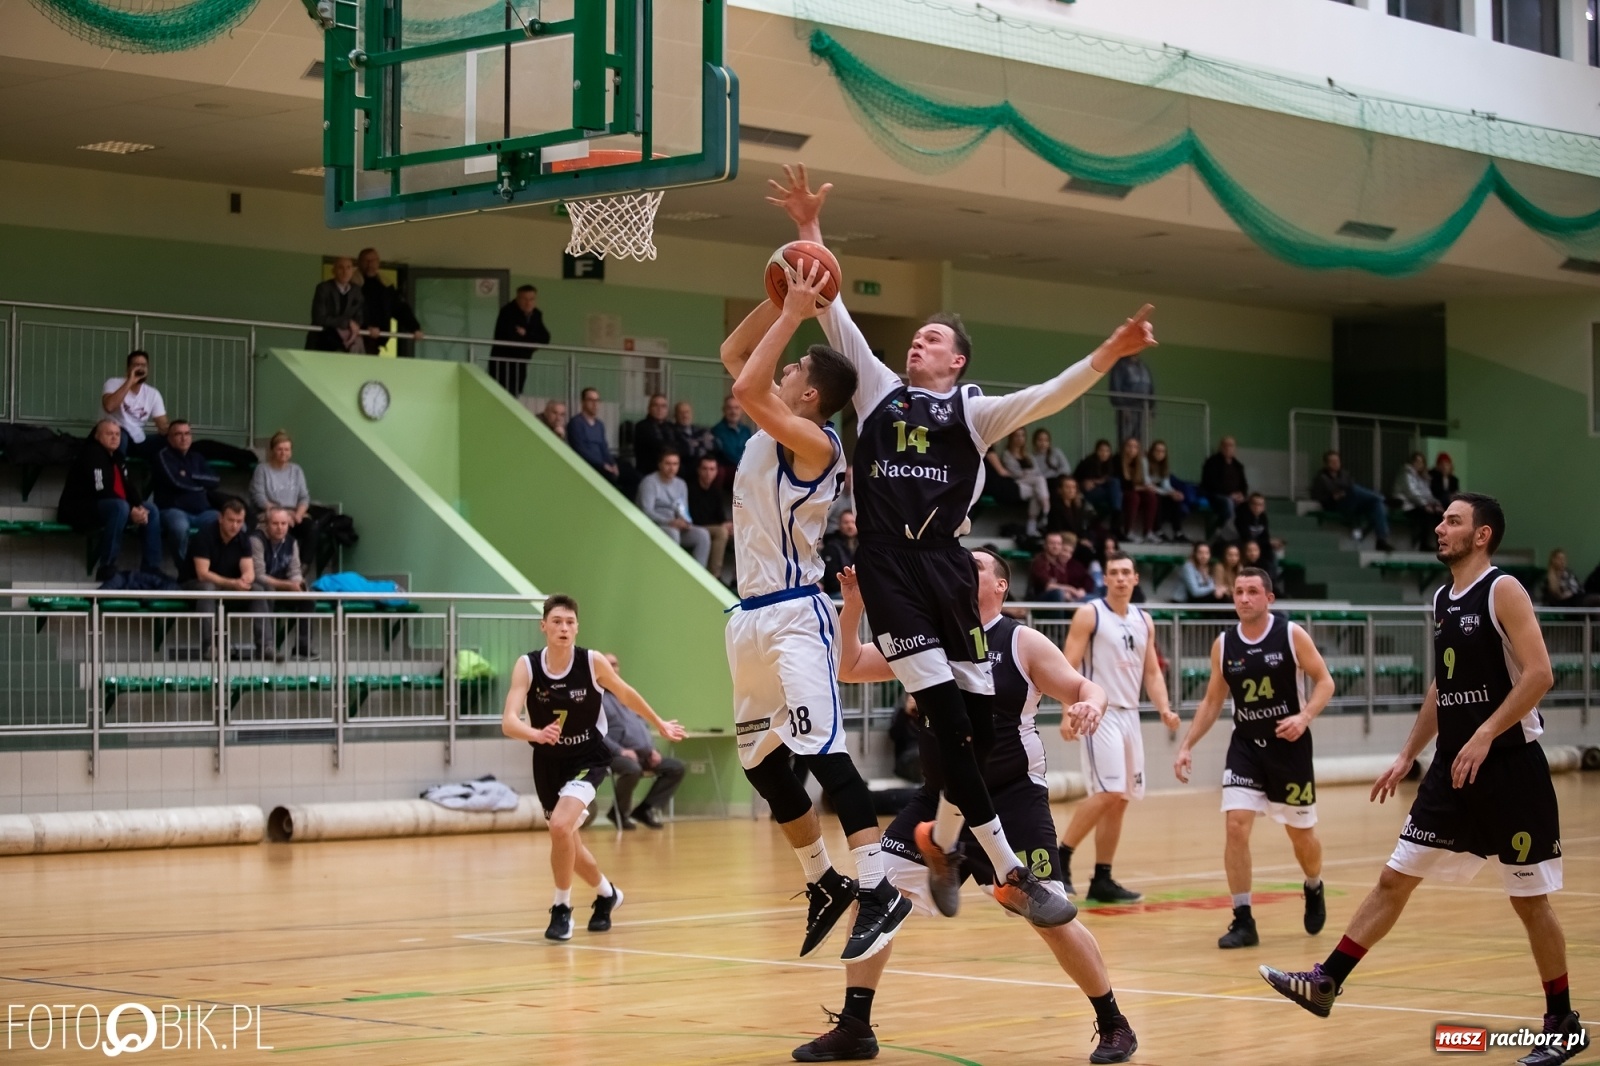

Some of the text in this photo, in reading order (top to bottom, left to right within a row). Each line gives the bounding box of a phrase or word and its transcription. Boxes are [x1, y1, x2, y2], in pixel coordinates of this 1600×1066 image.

[575, 260, 593, 276] F
[893, 420, 930, 454] 14
[873, 459, 949, 483] Nacomi
[1459, 615, 1481, 628] STELA
[969, 626, 989, 660] 1
[1122, 635, 1135, 651] 14
[1443, 647, 1456, 679] 9
[1242, 676, 1275, 703] 24
[553, 710, 568, 733] 7
[1237, 700, 1289, 722] Nacomi
[558, 729, 590, 746] comi
[1285, 782, 1313, 804] 24
[1511, 831, 1531, 862] 9
